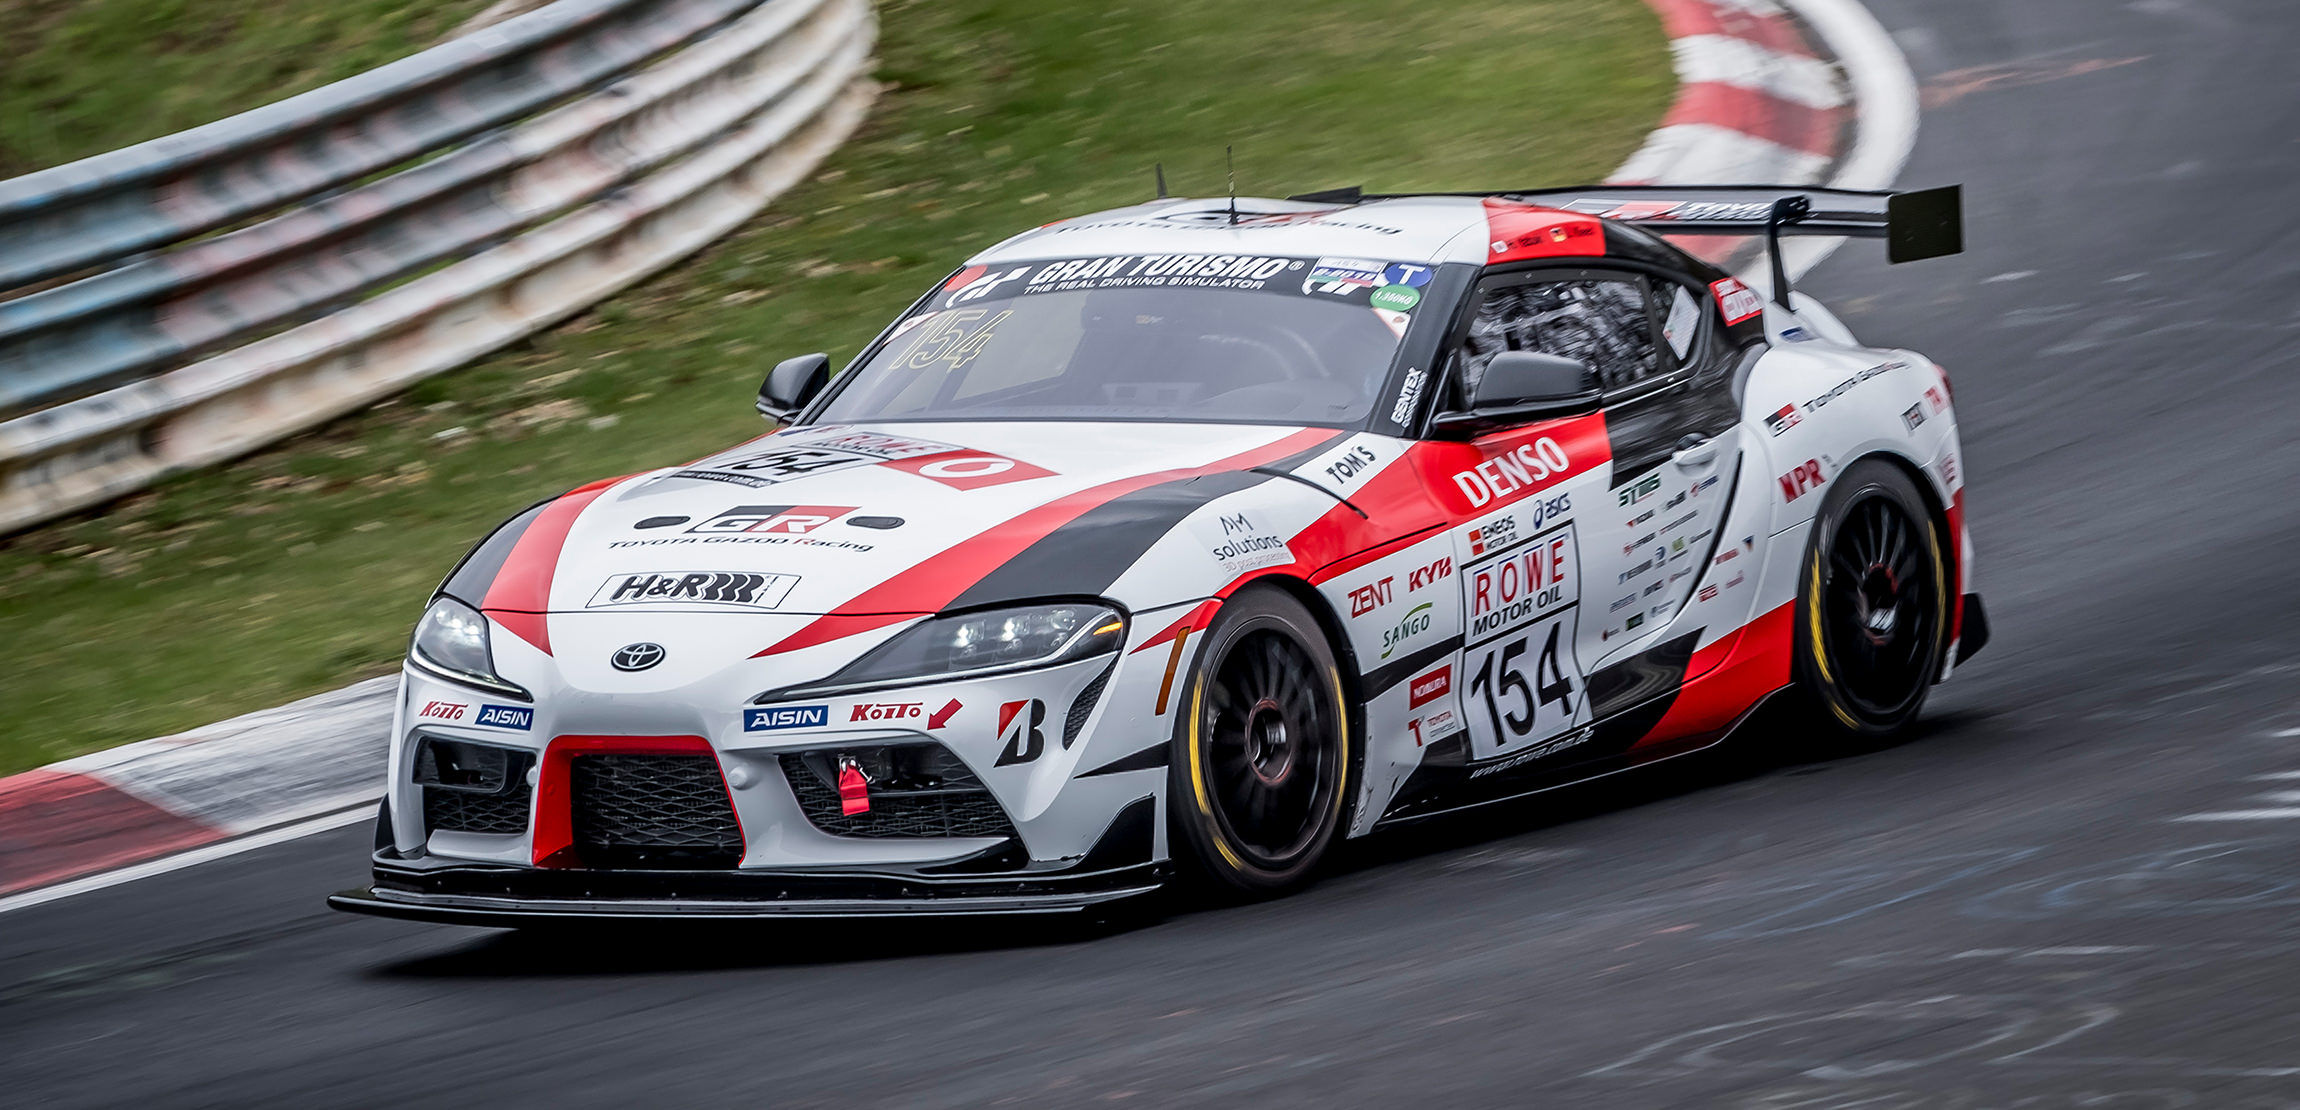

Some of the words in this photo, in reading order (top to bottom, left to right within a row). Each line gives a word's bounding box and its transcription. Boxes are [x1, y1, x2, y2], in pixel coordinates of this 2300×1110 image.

[1029, 255, 1135, 285] GRAN
[1399, 263, 1426, 284] T
[1024, 284, 1050, 295] THE
[1055, 280, 1096, 292] REAL
[1099, 276, 1165, 288] DRIVING
[1167, 276, 1266, 290] SIMULATOR
[888, 309, 1016, 374] 154
[1390, 366, 1423, 424] GENTEX
[714, 451, 864, 476] 154
[1325, 445, 1376, 485] TOM'S
[1452, 436, 1570, 509] DENSO
[688, 511, 844, 534] GR
[608, 537, 698, 550] TOYOTA
[702, 536, 790, 545] GAZOO
[793, 537, 876, 553] Racing
[1212, 534, 1284, 561] solutions
[609, 573, 714, 602] H&R
[1473, 540, 1566, 618] ROWE
[1347, 575, 1394, 619] ZENT
[1472, 598, 1533, 638] MOTOR
[1538, 584, 1563, 610] OIL
[1382, 613, 1431, 649] SANGO
[1470, 620, 1575, 748] 154
[479, 707, 532, 727] AISIN
[750, 707, 823, 728] AISIN
